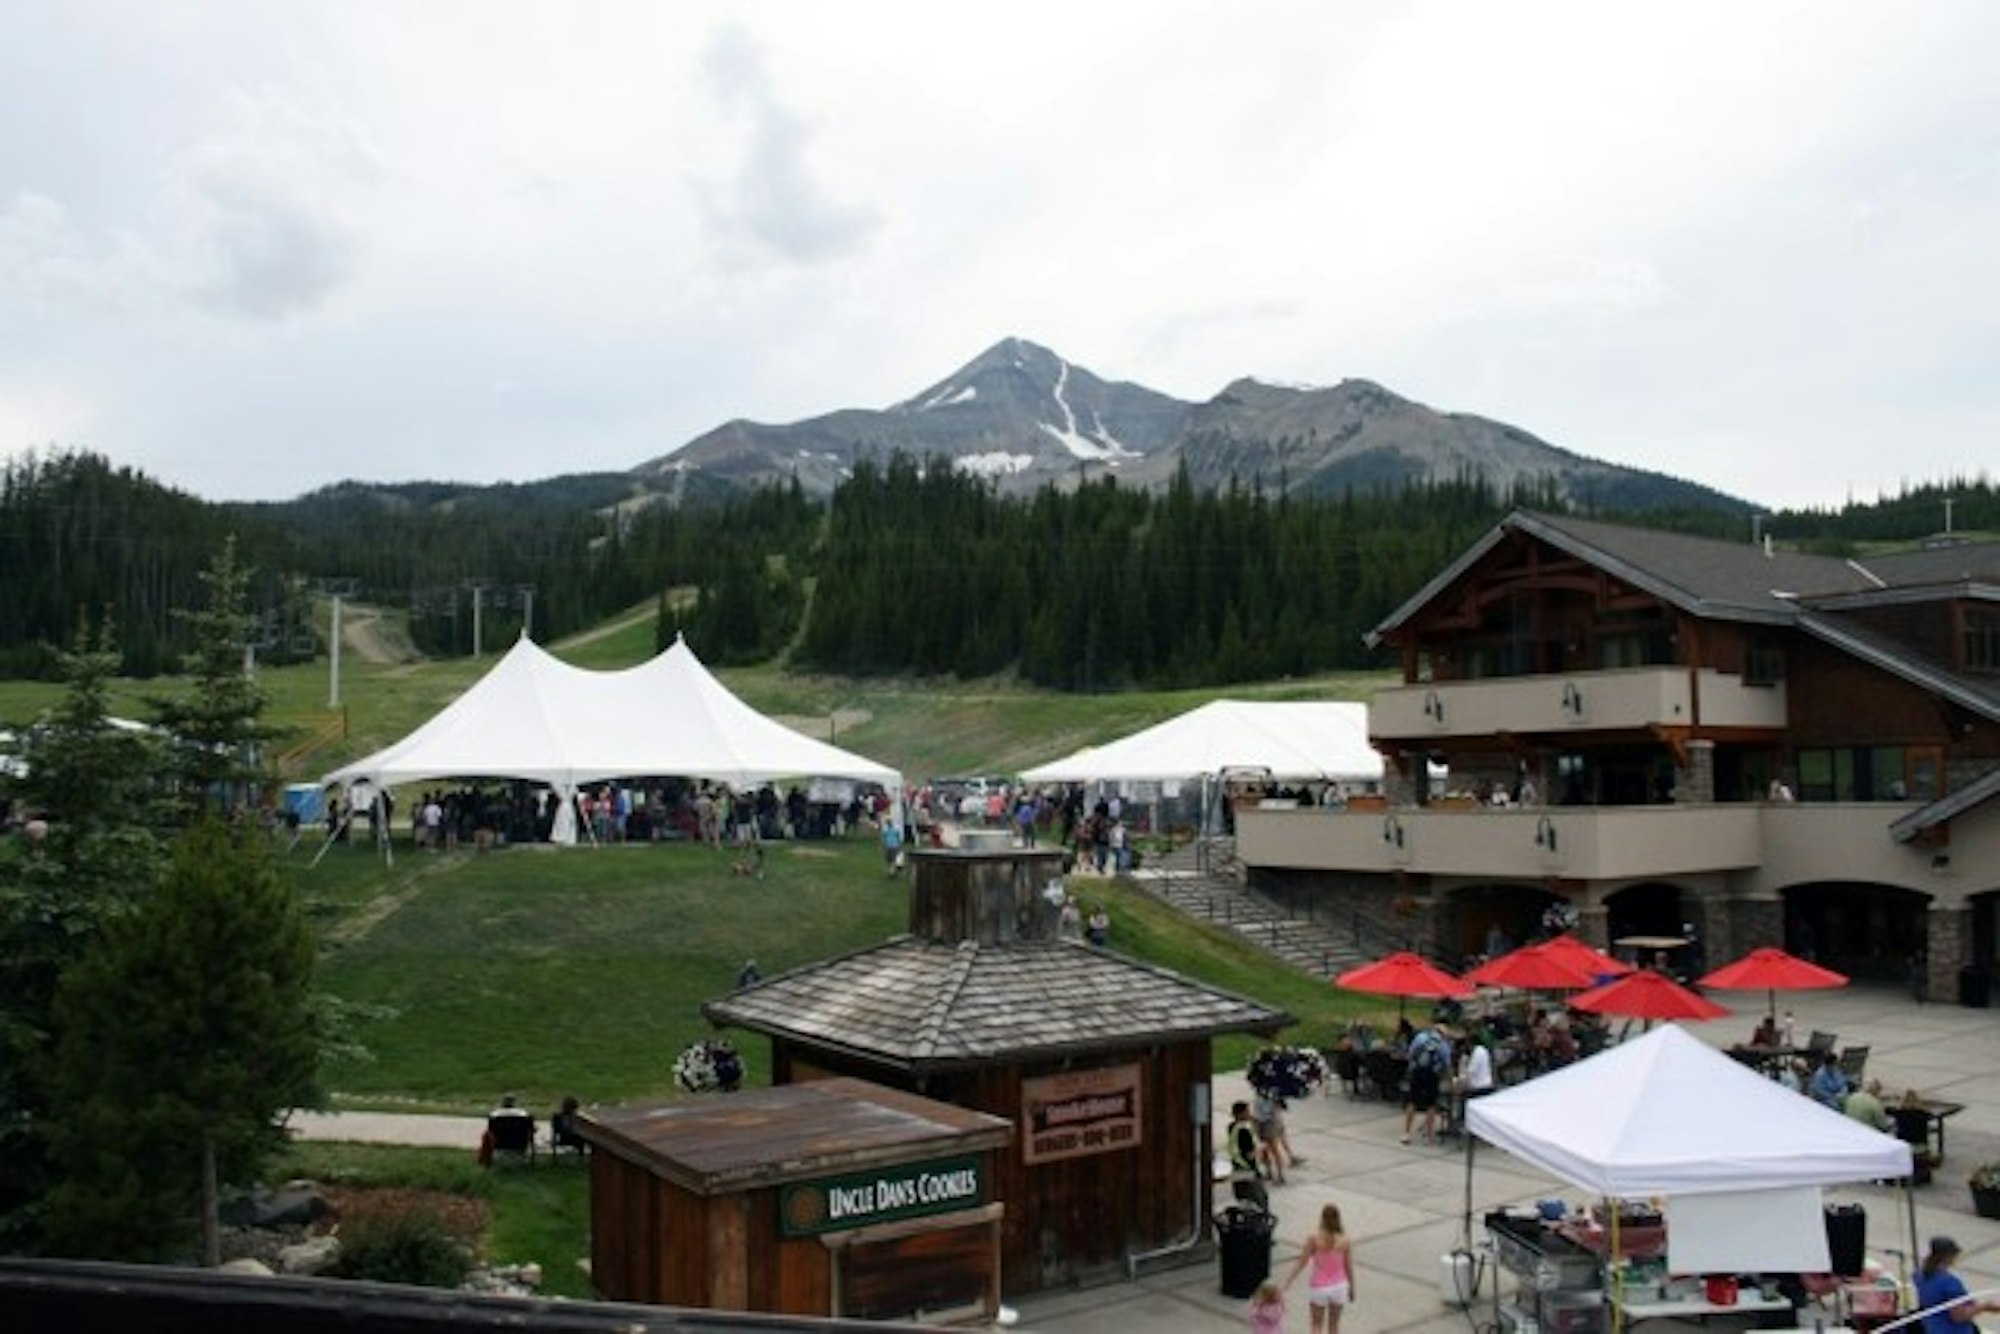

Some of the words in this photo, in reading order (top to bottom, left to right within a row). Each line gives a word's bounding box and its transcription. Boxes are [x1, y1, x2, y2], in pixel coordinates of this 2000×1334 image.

[829, 1186, 874, 1217] UNCLE
[876, 1178, 917, 1210] DAN'S
[918, 1169, 976, 1203] COOKIES
